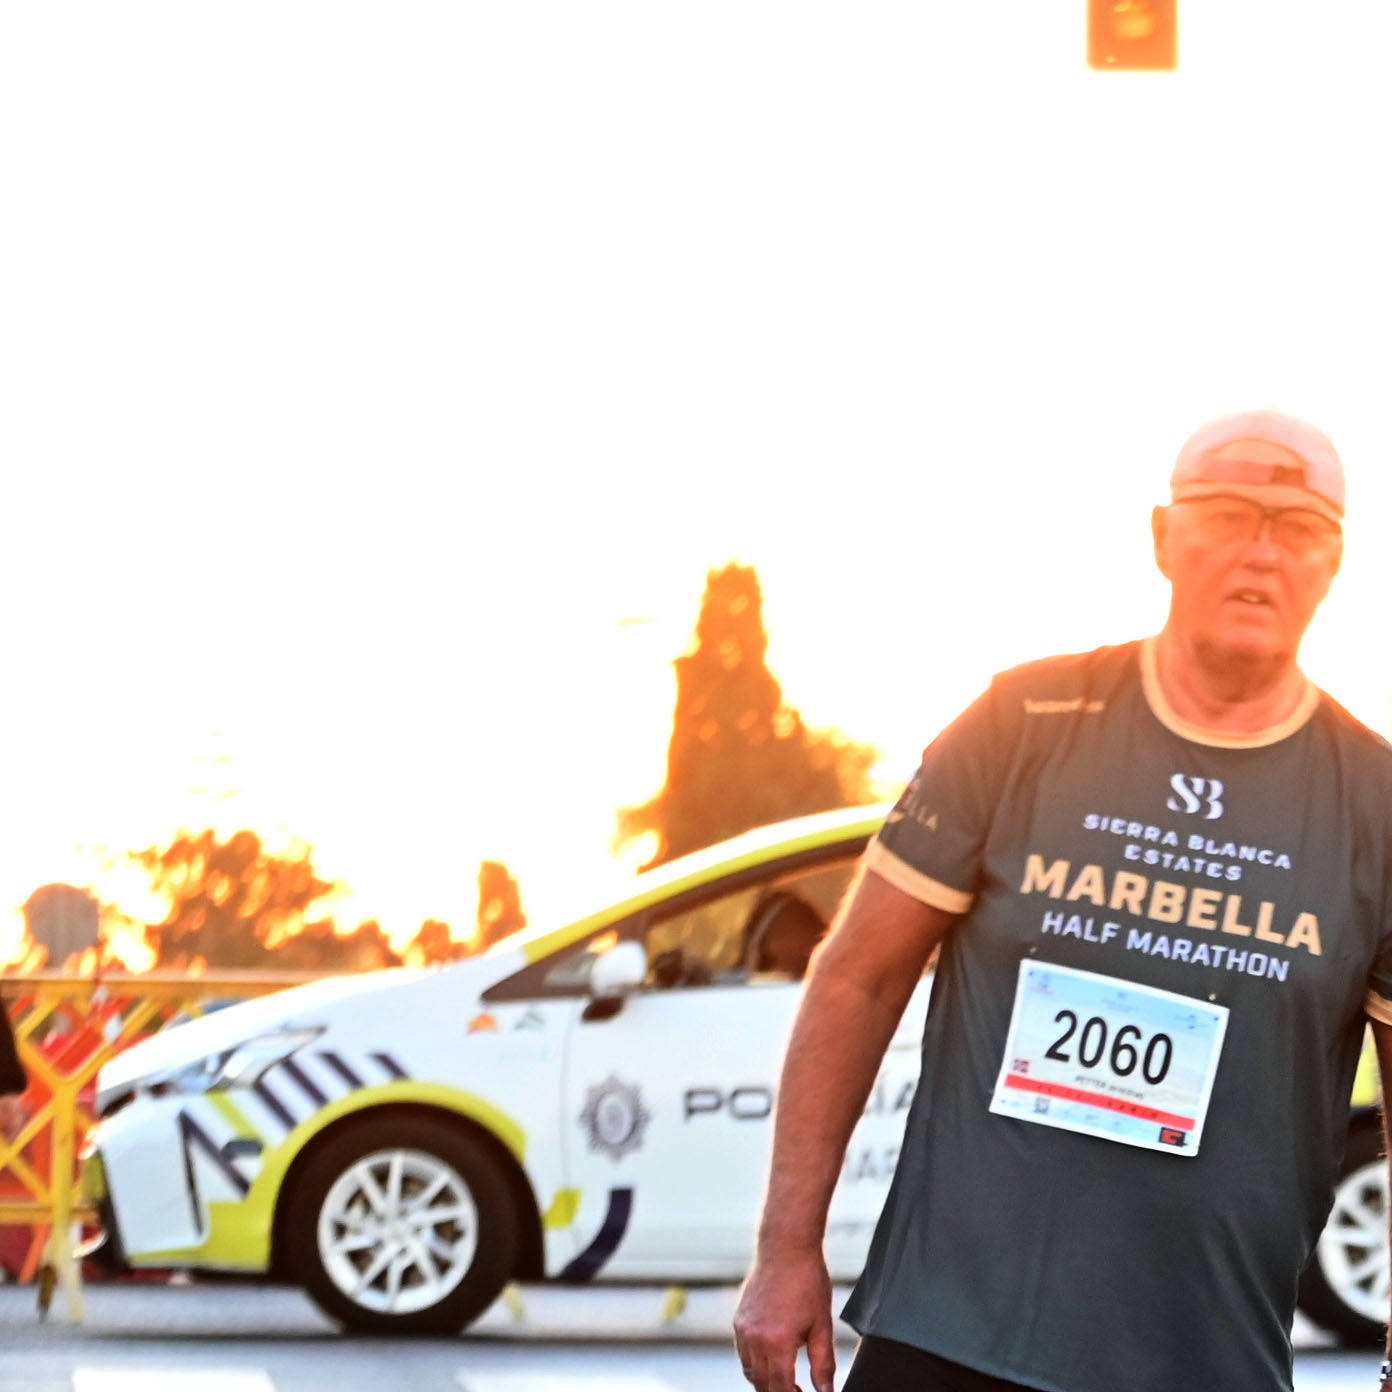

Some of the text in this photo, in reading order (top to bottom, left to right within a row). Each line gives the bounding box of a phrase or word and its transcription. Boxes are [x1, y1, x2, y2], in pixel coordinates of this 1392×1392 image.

[1082, 813, 1291, 870] SIERRA BLANCA
[1123, 844, 1243, 881] ESTATES
[1019, 854, 1323, 956] MARBELLA
[1040, 911, 1290, 982] HALF MARATHON
[1045, 1009, 1173, 1085] 2060
